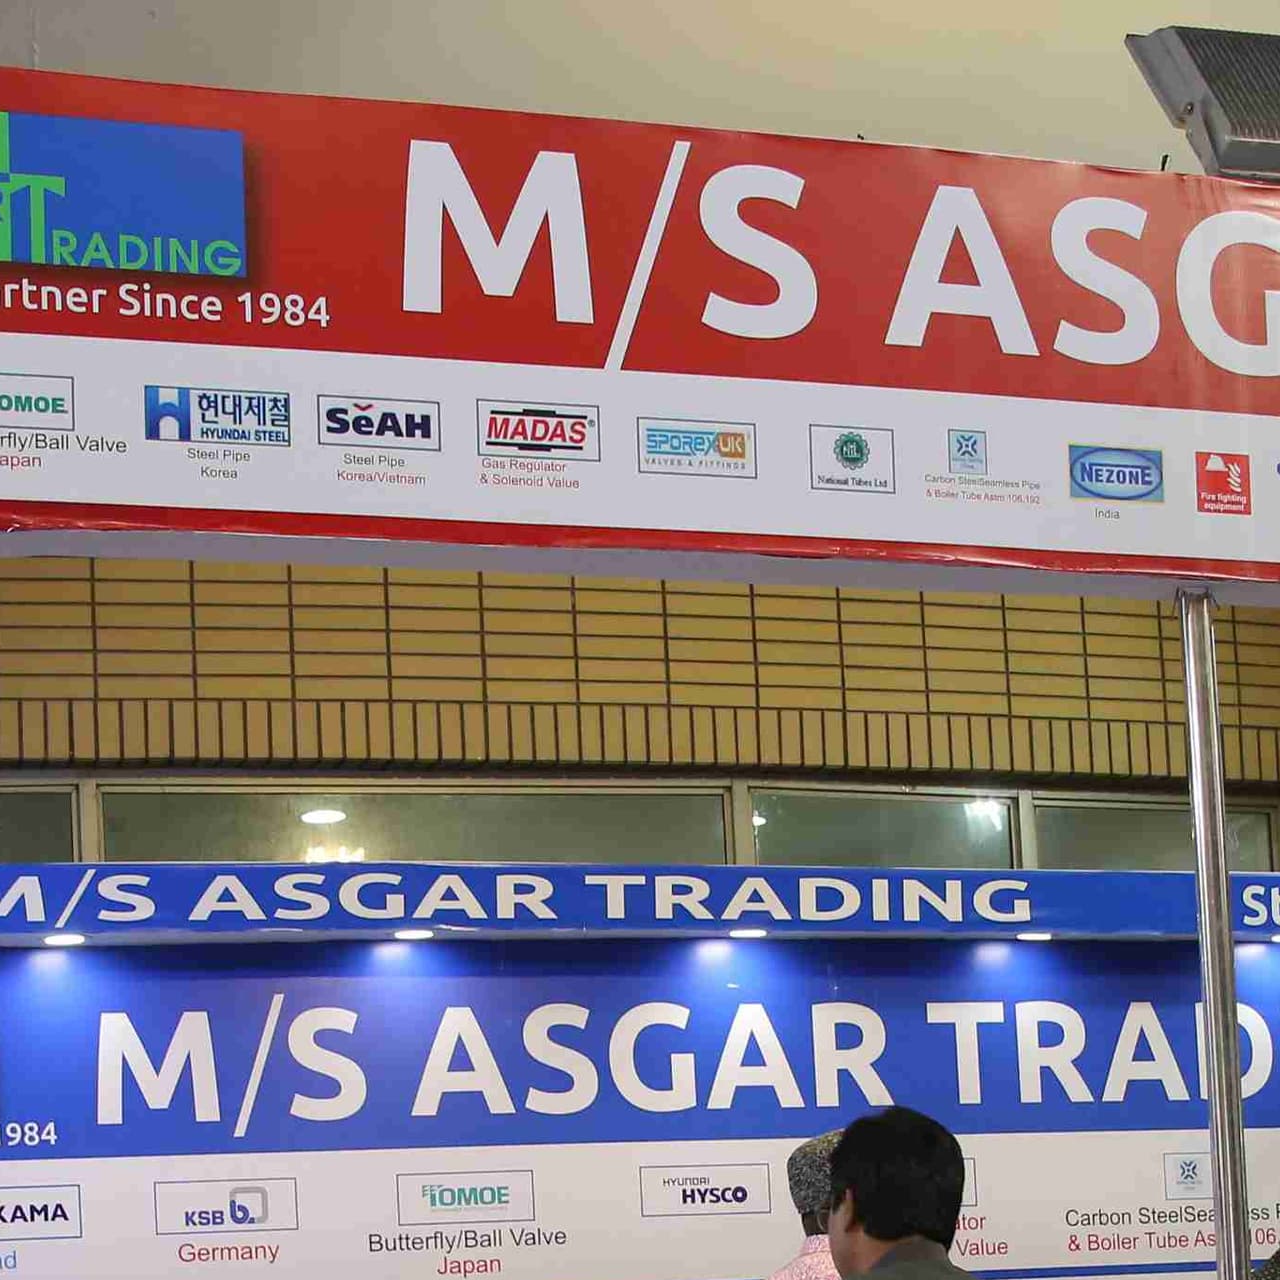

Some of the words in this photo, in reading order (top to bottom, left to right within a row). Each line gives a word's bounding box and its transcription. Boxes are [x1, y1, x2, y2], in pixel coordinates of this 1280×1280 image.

[10, 174, 243, 277] TRADING
[403, 139, 820, 370] M/S
[117, 282, 223, 323] Since
[236, 291, 331, 328] 1984
[198, 393, 289, 427] 현대제철
[200, 427, 251, 441] HYUNDAI
[255, 430, 288, 443] STEEL
[487, 415, 587, 444] MADAS
[76, 436, 127, 453] Valve
[187, 448, 219, 461] Steel
[223, 449, 251, 463] Pipe
[344, 453, 375, 467] Steel
[378, 456, 405, 469] Pipe
[200, 466, 239, 480] Korea
[482, 458, 506, 471] Gas
[510, 459, 567, 474] Regulator
[1080, 463, 1153, 485] NEZONE
[337, 470, 426, 485] Korea/Vietnam
[480, 474, 489, 485] &
[492, 474, 543, 487] Solenoid
[547, 476, 580, 489] Value
[1201, 492, 1216, 503] Fire
[1095, 508, 1120, 520] India
[188, 873, 558, 923] ASGAR
[585, 874, 1031, 924] TRADING
[96, 990, 368, 1137] M/S
[410, 1002, 895, 1123] ASGAR
[662, 1177, 709, 1187] HYUNDAI
[423, 1184, 510, 1207] TOMOE
[682, 1186, 748, 1204] HYSCO
[185, 1210, 224, 1226] KSB
[1065, 1207, 1132, 1228] Carbon
[369, 1229, 502, 1254] Butterfly/Ball
[510, 1229, 567, 1247] Valve
[956, 1238, 1008, 1256] Value
[1068, 1234, 1081, 1252] &
[1087, 1233, 1139, 1252] Boiler
[1144, 1232, 1189, 1250] Tube
[1194, 1229, 1217, 1248] As
[178, 1242, 280, 1264] Germany
[437, 1256, 502, 1277] Japan
